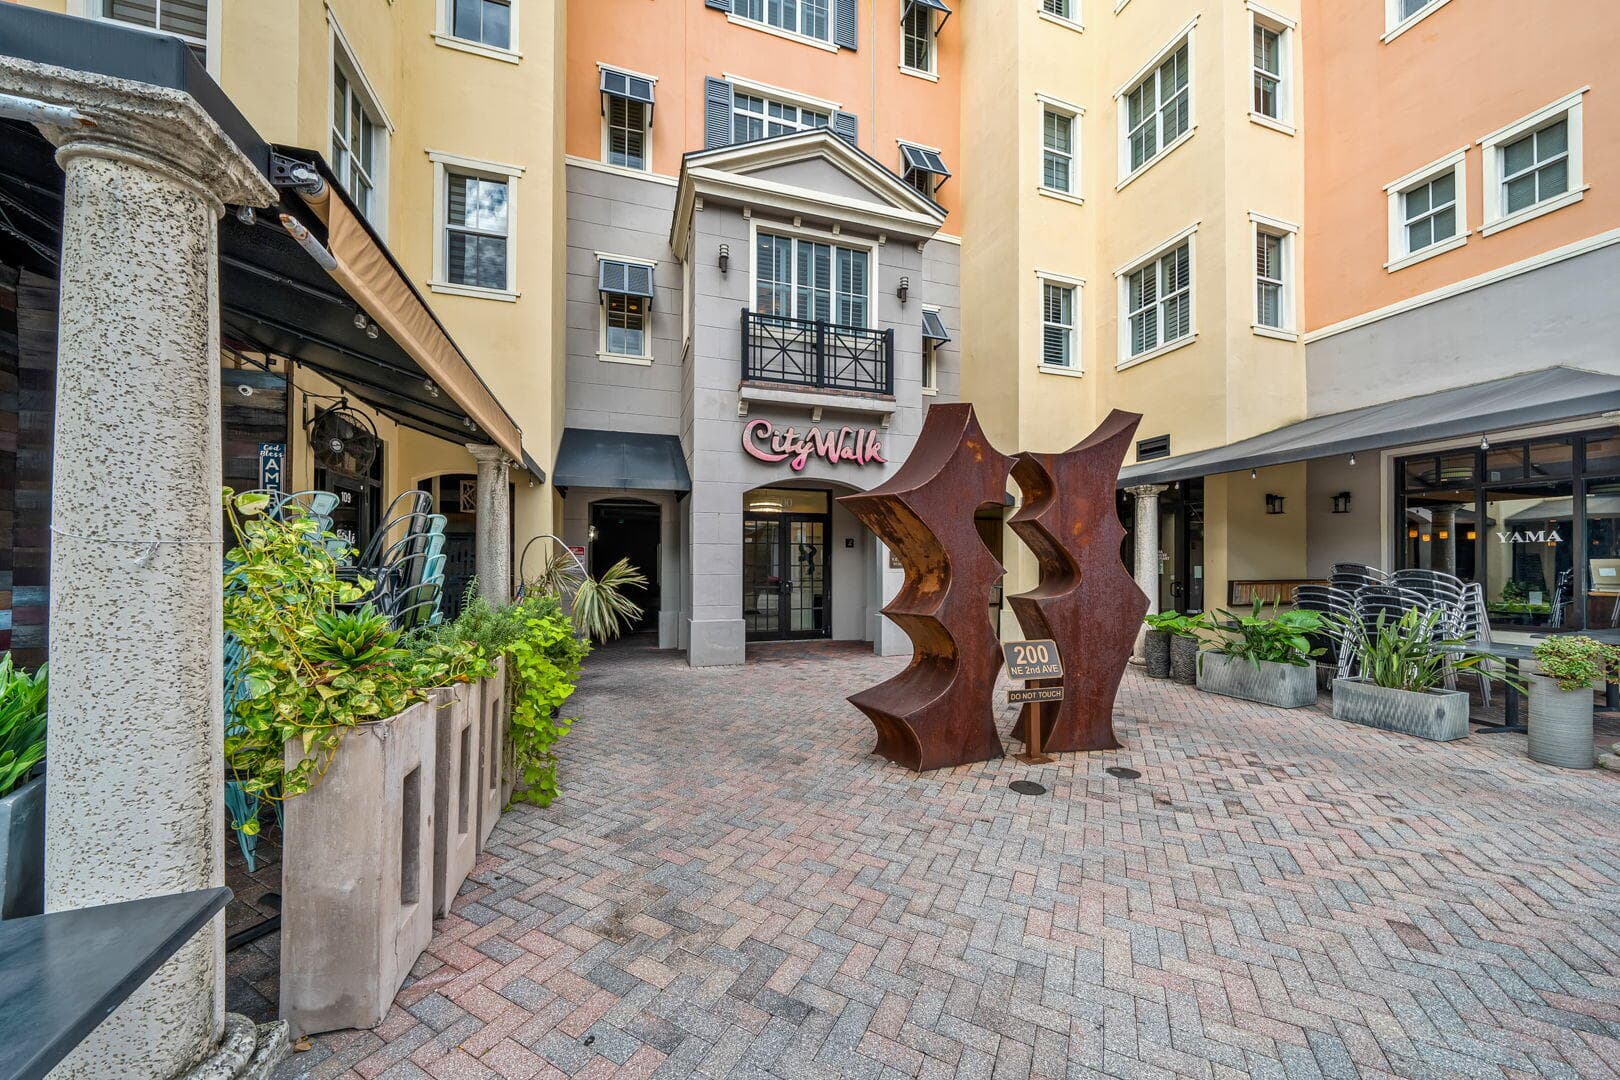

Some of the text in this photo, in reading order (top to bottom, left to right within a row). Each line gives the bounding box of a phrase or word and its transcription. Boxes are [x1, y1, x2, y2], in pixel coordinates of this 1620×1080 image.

[260, 450, 283, 458] Bless
[341, 491, 352, 504] 109
[1495, 530, 1564, 544] YAMA
[1013, 645, 1049, 665] 200
[1011, 664, 1059, 675] NE 2nd AVE
[1039, 690, 1061, 699] TOUCH
